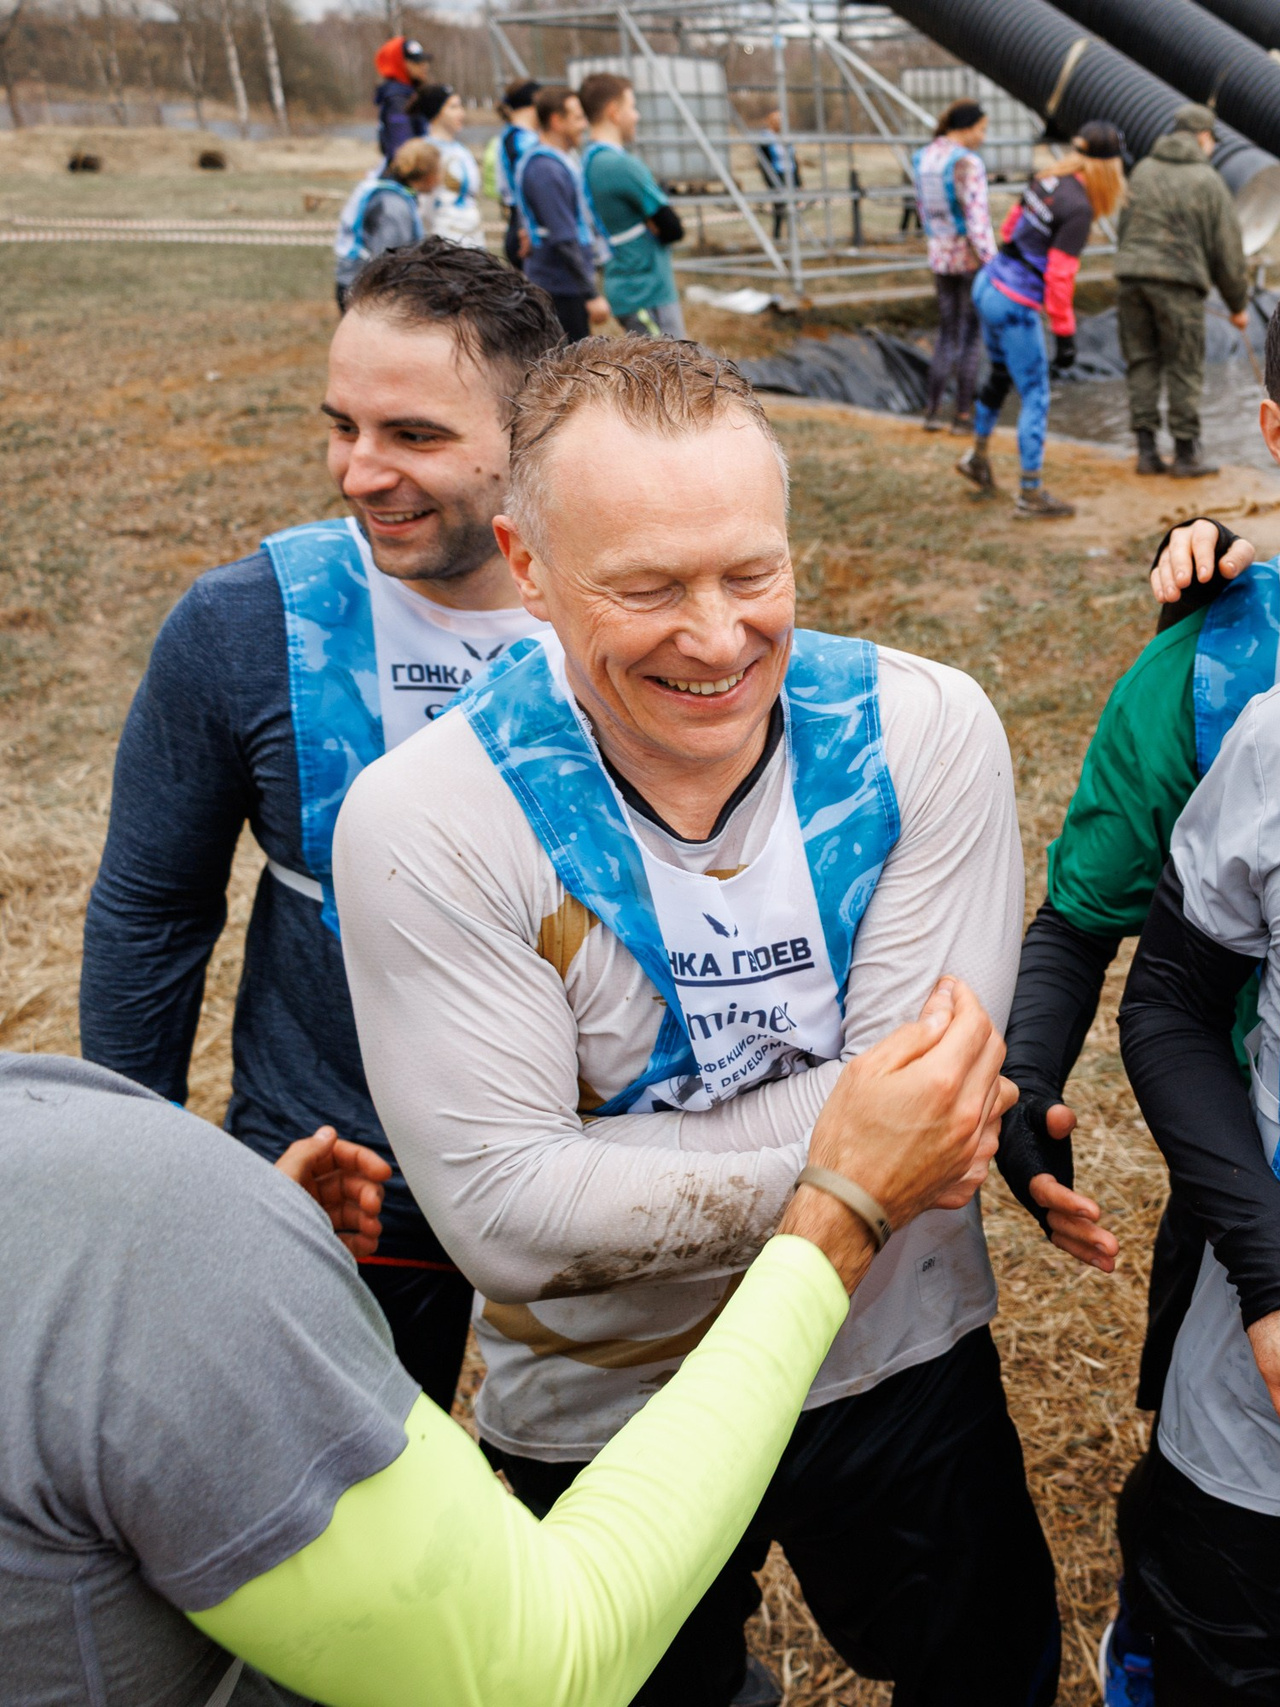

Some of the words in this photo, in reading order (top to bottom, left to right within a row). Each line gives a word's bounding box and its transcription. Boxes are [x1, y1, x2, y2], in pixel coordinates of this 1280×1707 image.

[391, 664, 473, 684] ГОНКА
[667, 950, 722, 977] НКА
[685, 1002, 798, 1041] minex
[721, 1040, 791, 1088] DEVELOPM
